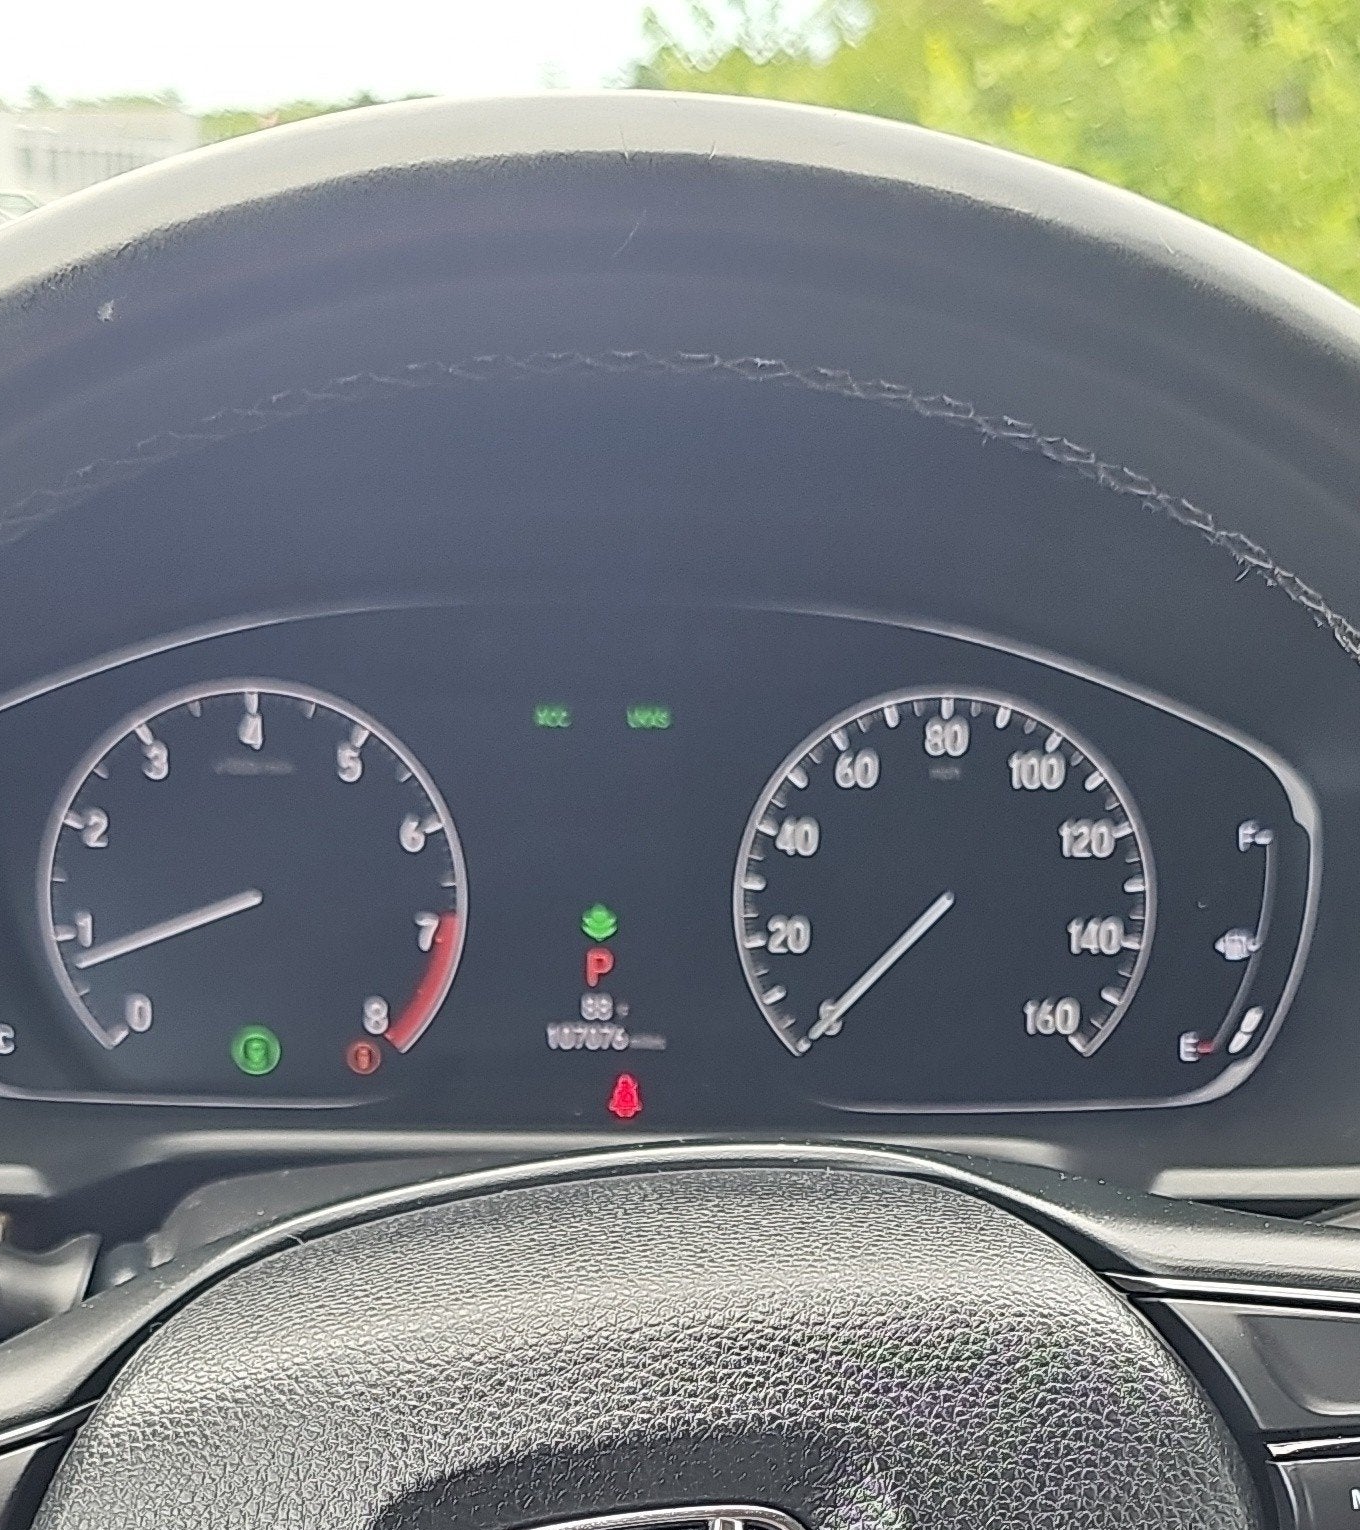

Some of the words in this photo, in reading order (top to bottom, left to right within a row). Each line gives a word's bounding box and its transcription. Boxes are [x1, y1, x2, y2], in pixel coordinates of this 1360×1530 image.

[239, 709, 264, 750] 4
[922, 716, 970, 759] 80
[145, 740, 170, 781] 3
[338, 742, 363, 783] 5
[834, 748, 881, 790] 60
[1008, 751, 1067, 791] 100
[81, 805, 110, 848] 2
[398, 814, 426, 853] 6
[773, 816, 821, 857] 40
[1058, 819, 1116, 860] 120
[75, 909, 93, 949] 1
[413, 911, 439, 953] 7
[767, 913, 811, 955] 20
[1067, 916, 1124, 957] 140
[585, 945, 616, 988] P
[127, 992, 153, 1032] 0
[362, 995, 390, 1034] 8
[1023, 999, 1082, 1037] 160
